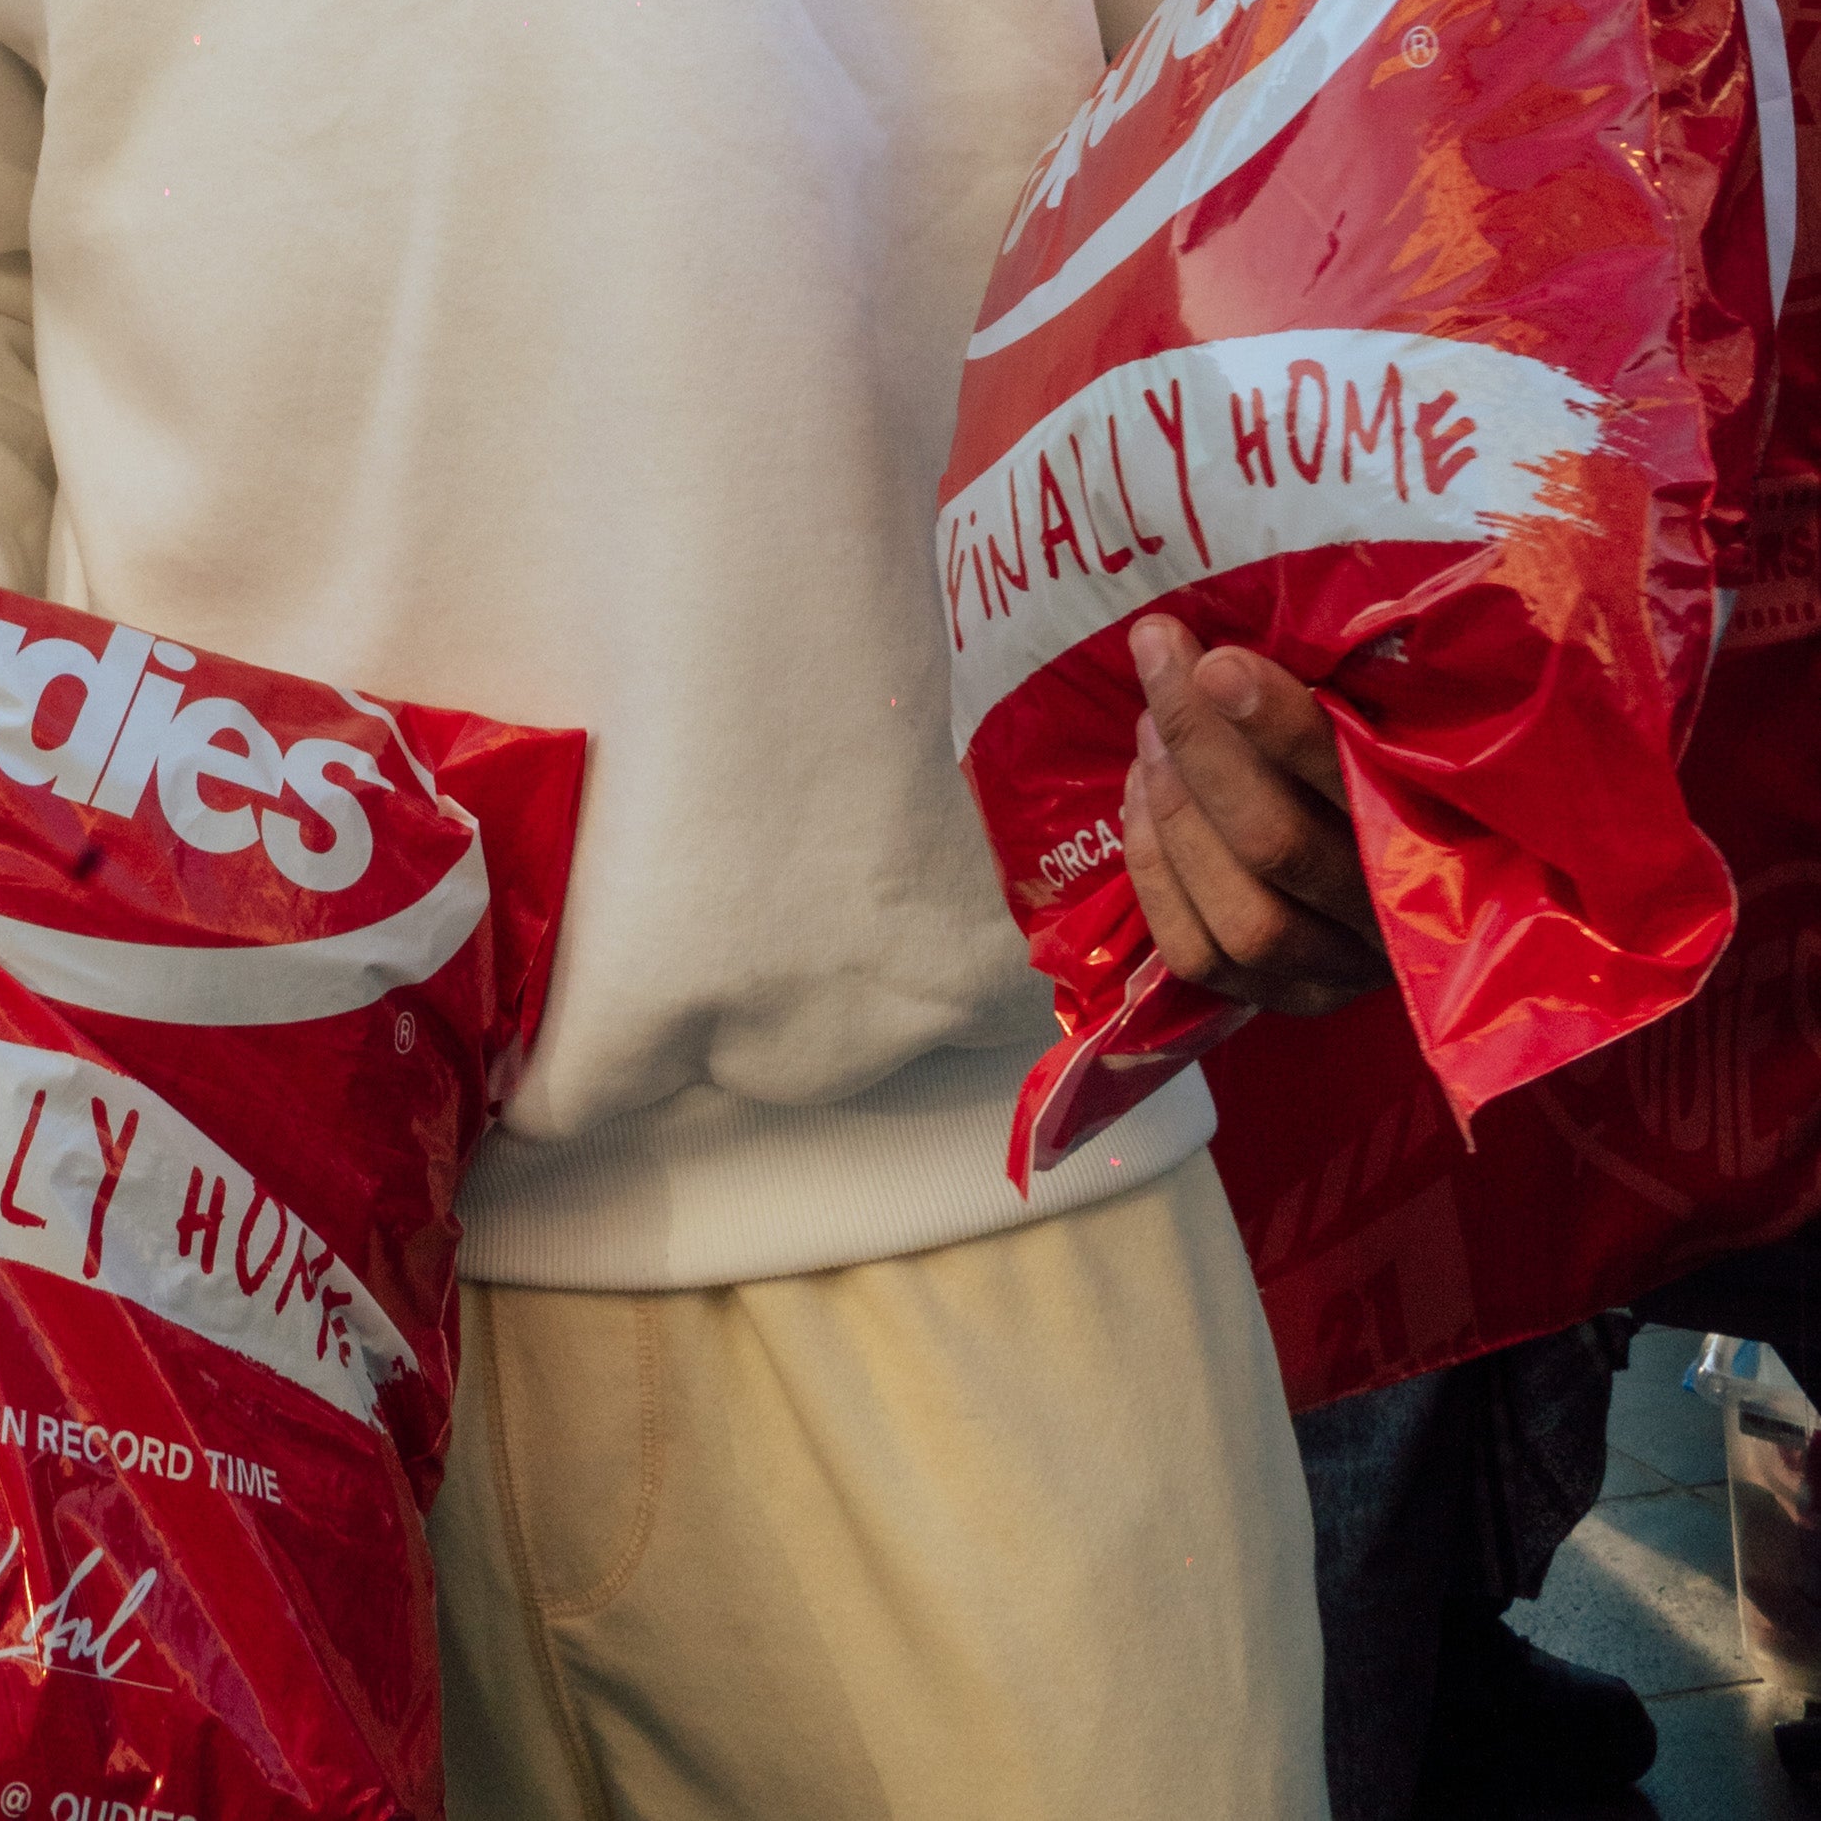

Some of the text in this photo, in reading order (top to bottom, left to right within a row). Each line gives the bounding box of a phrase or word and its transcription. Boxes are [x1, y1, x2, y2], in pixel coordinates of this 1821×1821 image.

[1231, 358, 1478, 503] HOME
[1039, 819, 1124, 889] CIRCA
[37, 1413, 194, 1483] RECORD
[204, 1447, 282, 1505] TIME
[0, 1780, 33, 1818] @
